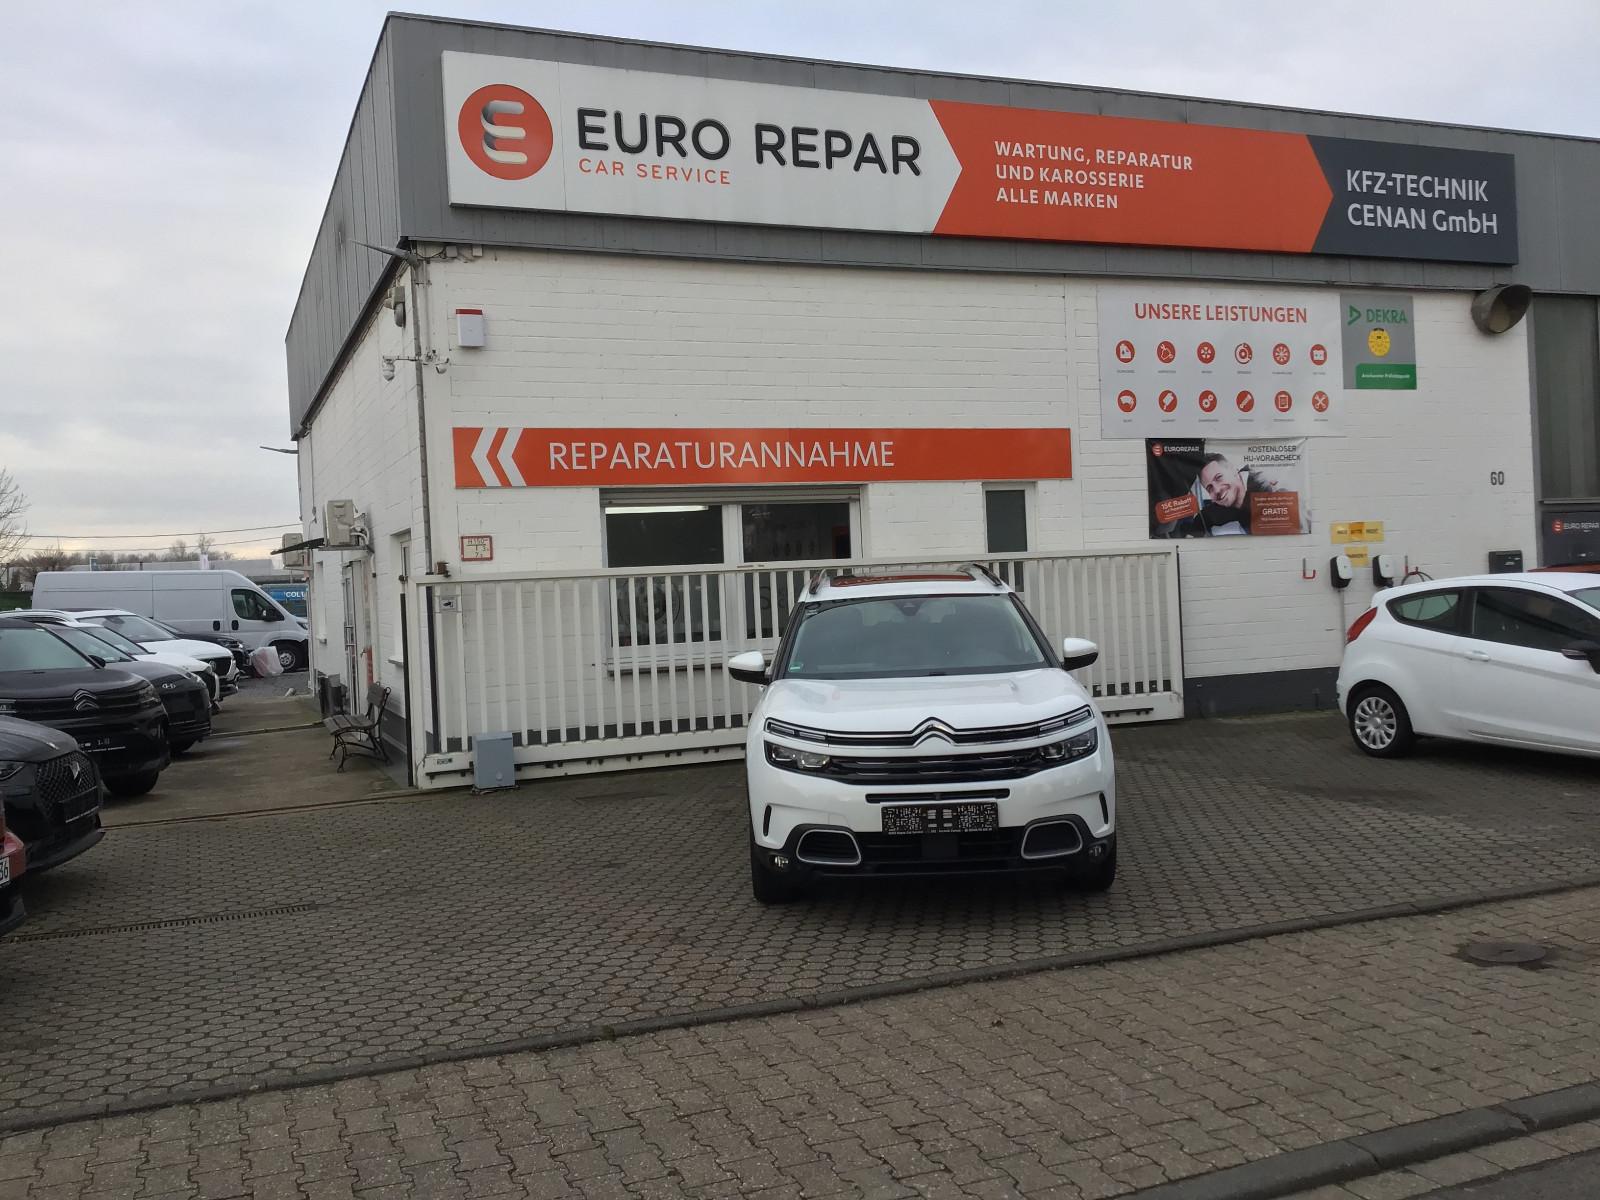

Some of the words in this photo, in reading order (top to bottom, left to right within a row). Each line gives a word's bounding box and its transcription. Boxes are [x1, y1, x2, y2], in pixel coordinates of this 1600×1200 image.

[577, 107, 731, 160] EURO
[754, 122, 921, 176] REPAR
[995, 141, 1090, 163] WARTUNG,
[1095, 149, 1193, 171] REPARATUR
[578, 158, 625, 176] CAR
[637, 164, 731, 185] SERVICE
[995, 164, 1035, 181] UND
[1039, 168, 1144, 189] KAROSSERIE
[1346, 169, 1488, 202] KFZ-TECHNIK
[996, 188, 1039, 205] ALLE
[1044, 191, 1118, 209] MARKEN
[1347, 203, 1427, 230] CENAN
[1432, 209, 1498, 235] GmbH
[1134, 303, 1201, 320] UNSERE
[1206, 304, 1307, 323] LEISTUNGEN
[1366, 308, 1408, 324] DEKRA
[549, 441, 895, 470] REPARATURANNAHME
[1243, 454, 1301, 462] HU-VORABCHECK
[1248, 445, 1297, 453] KOSTENLOSER
[1490, 471, 1505, 486] 60
[1262, 507, 1288, 516] GRATIS
